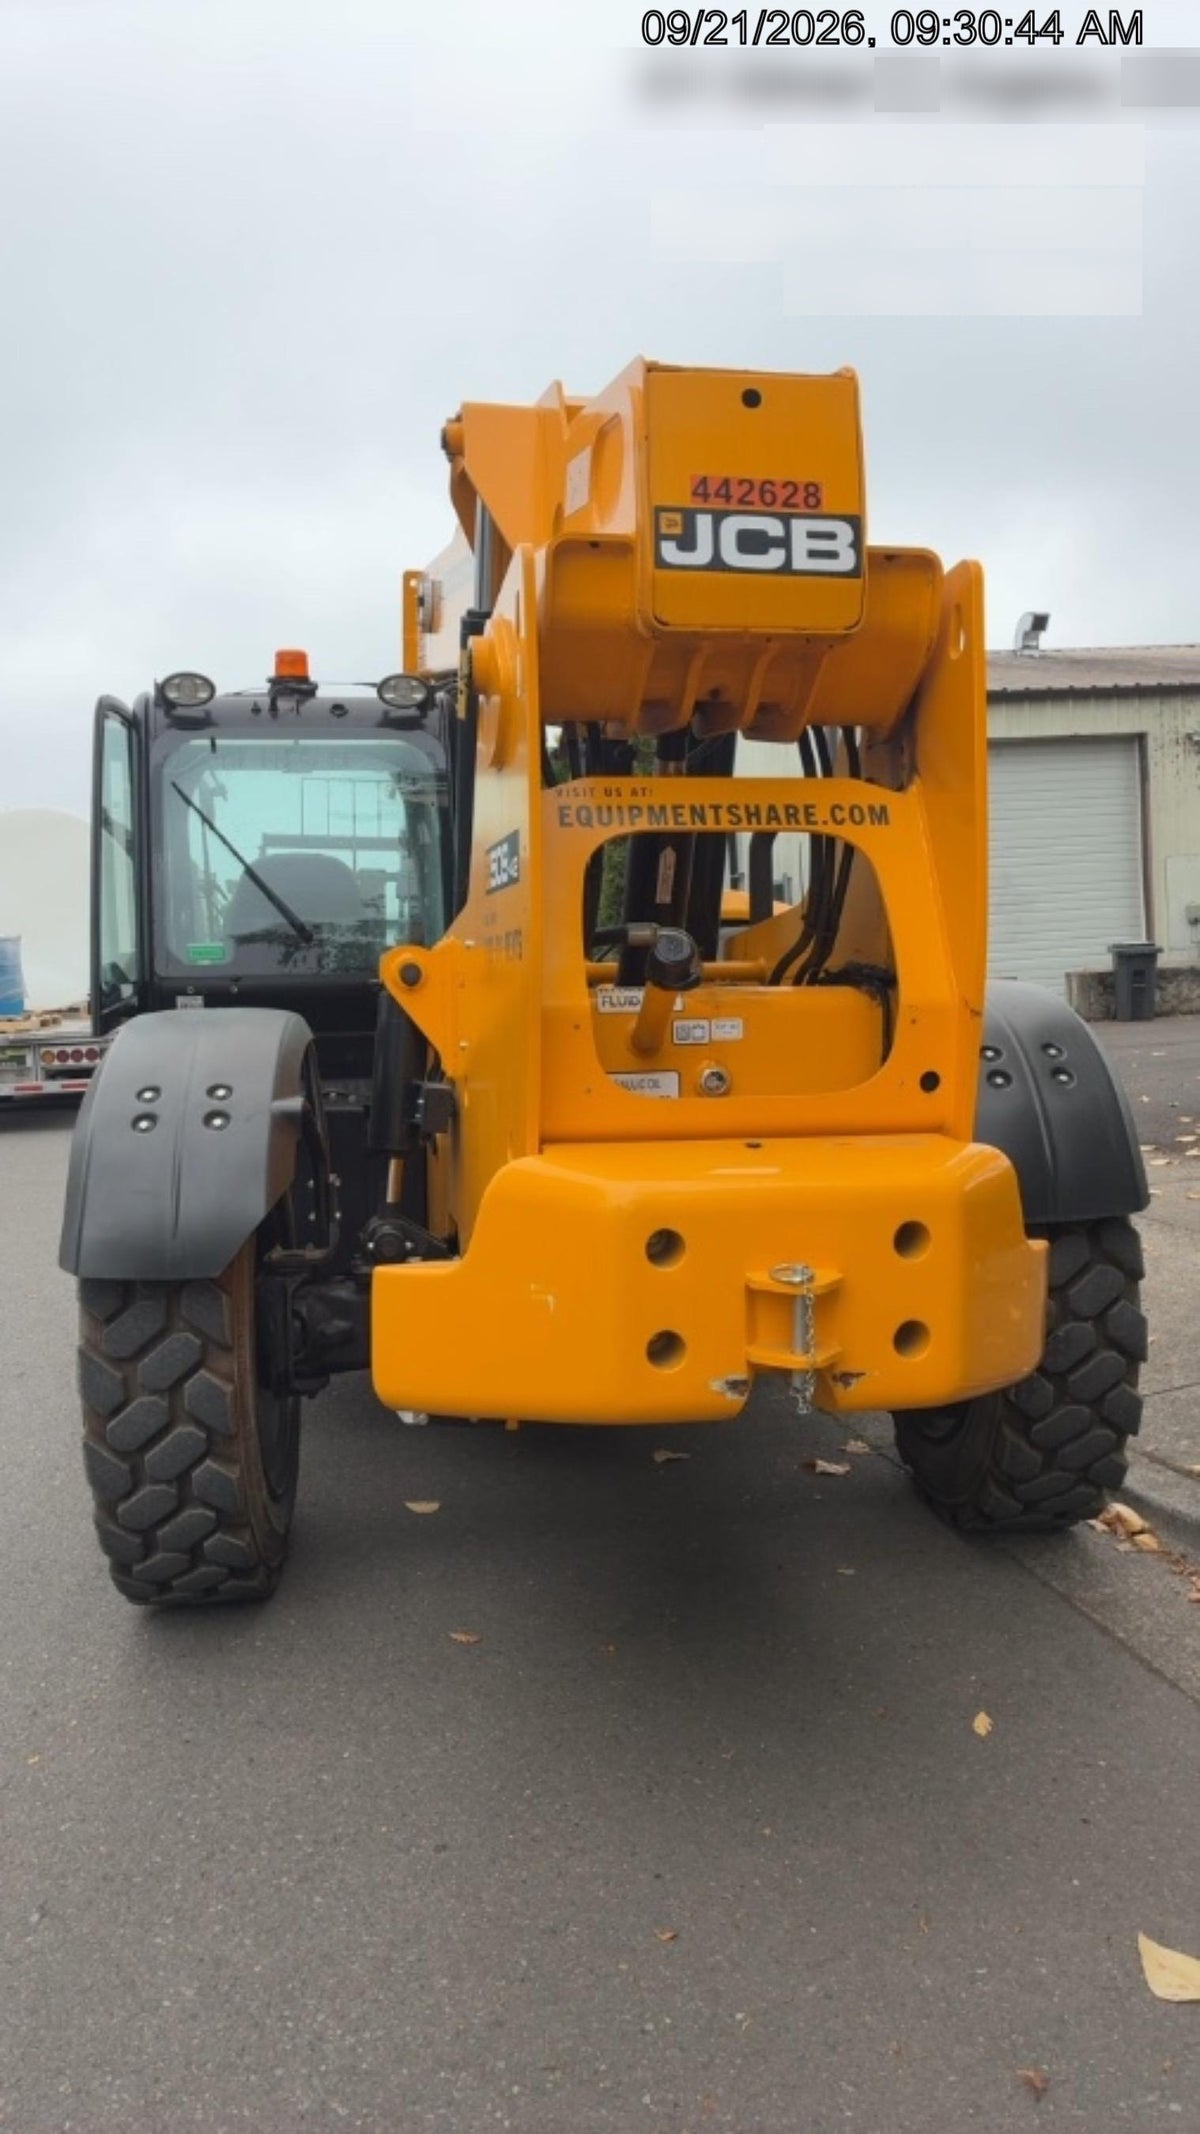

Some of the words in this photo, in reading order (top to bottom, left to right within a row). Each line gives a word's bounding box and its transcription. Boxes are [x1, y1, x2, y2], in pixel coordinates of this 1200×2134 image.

[691, 476, 822, 510] 442628
[660, 513, 857, 572] JCB
[604, 786, 622, 797] US
[558, 803, 890, 828] EQUIPMENTSHARE.COM
